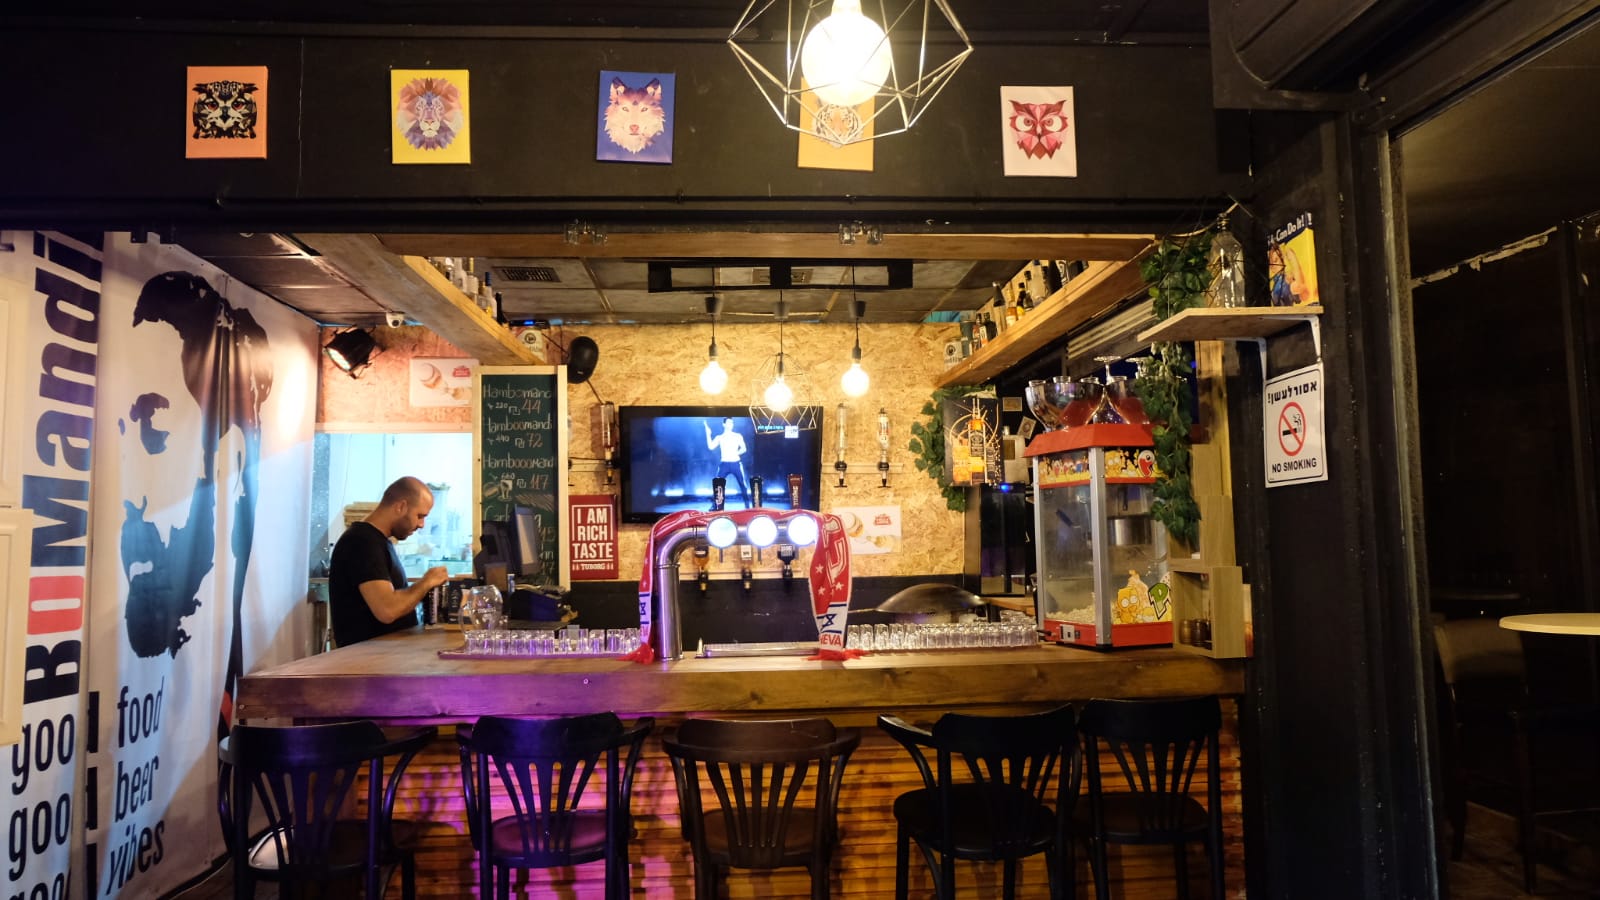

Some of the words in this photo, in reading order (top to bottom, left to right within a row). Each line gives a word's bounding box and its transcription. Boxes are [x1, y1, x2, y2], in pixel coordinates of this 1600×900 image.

[521, 398, 542, 415] 44
[526, 432, 544, 448] 72
[23, 231, 104, 704] BOMandi
[1272, 463, 1282, 473] NO
[1283, 457, 1317, 472] SMOKING
[577, 508, 582, 524] I
[587, 507, 607, 524] AM
[577, 525, 608, 541] RICH
[572, 542, 614, 559] TASTE
[117, 676, 164, 748] food
[114, 755, 159, 823] beer
[104, 820, 165, 896] vibes
